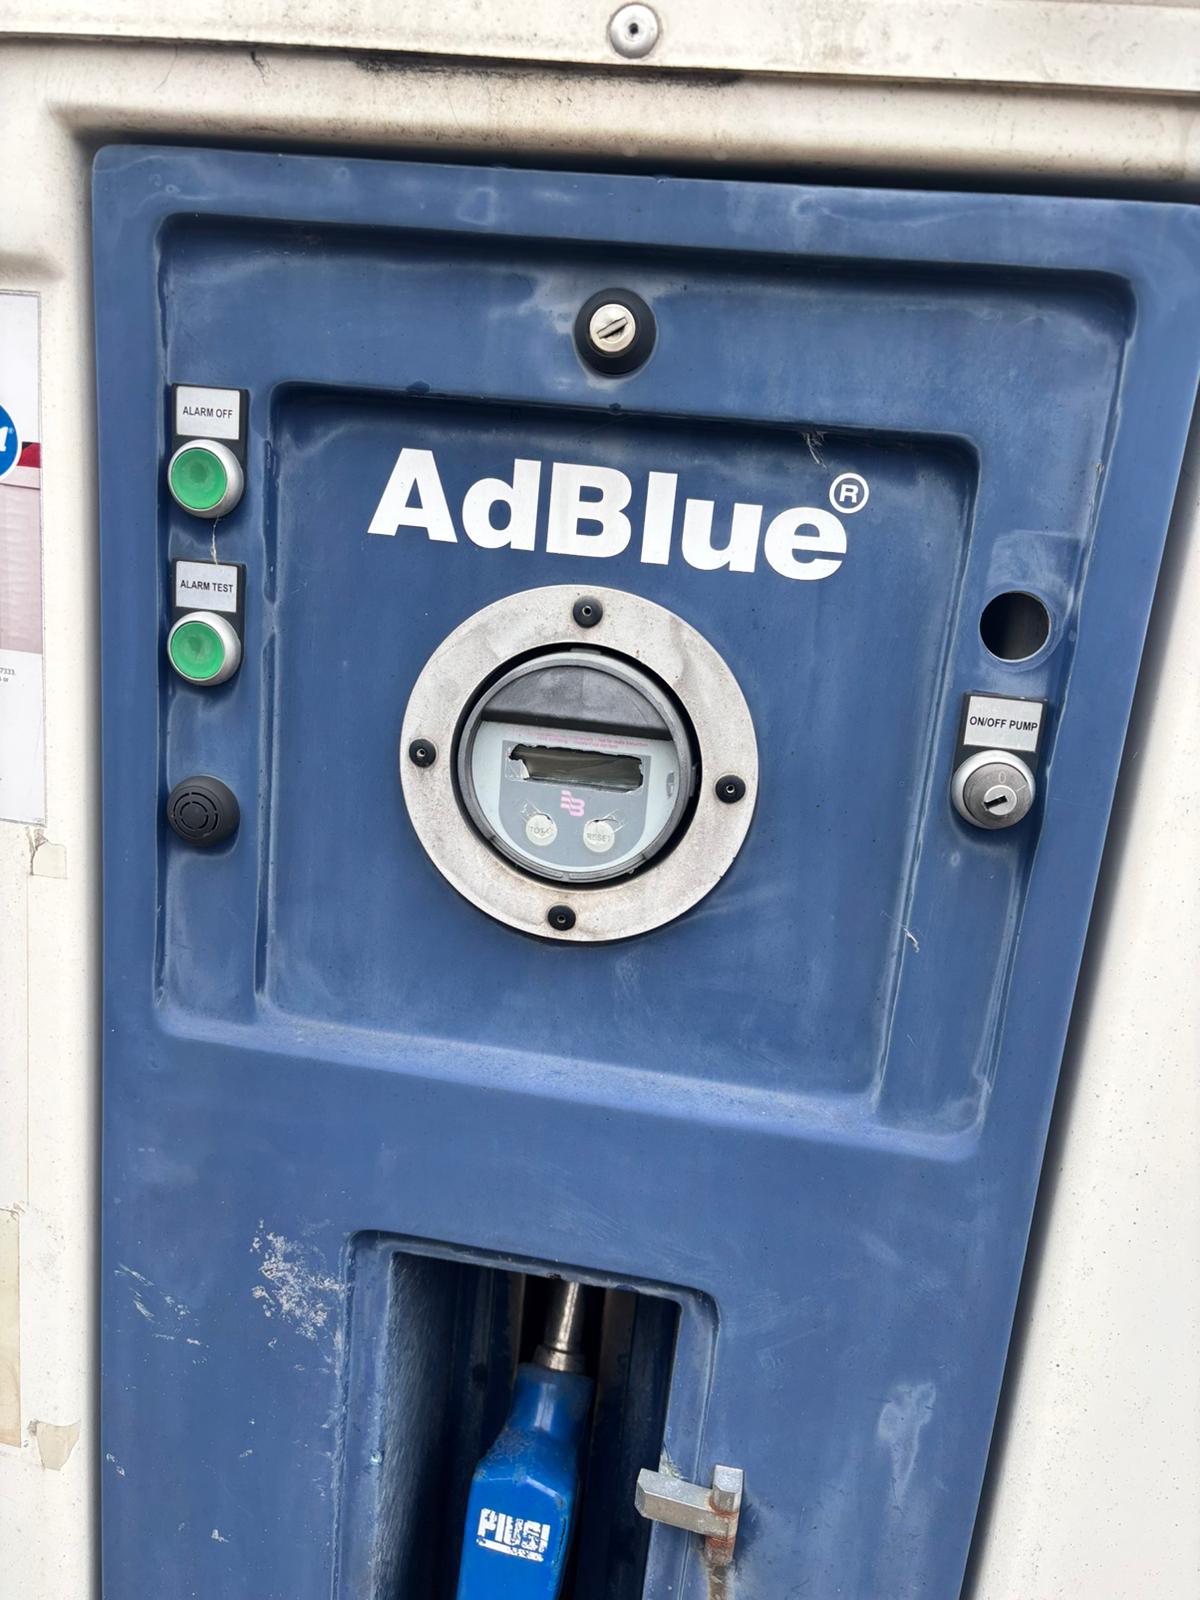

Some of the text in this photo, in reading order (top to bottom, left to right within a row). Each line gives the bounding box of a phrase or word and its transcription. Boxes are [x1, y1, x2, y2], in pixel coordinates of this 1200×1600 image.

[182, 405, 233, 419] ALARM OFF
[180, 578, 234, 594] ALARM TEST
[969, 716, 1038, 732] ON/OFF PUMP
[477, 1507, 551, 1553] PIUSI
